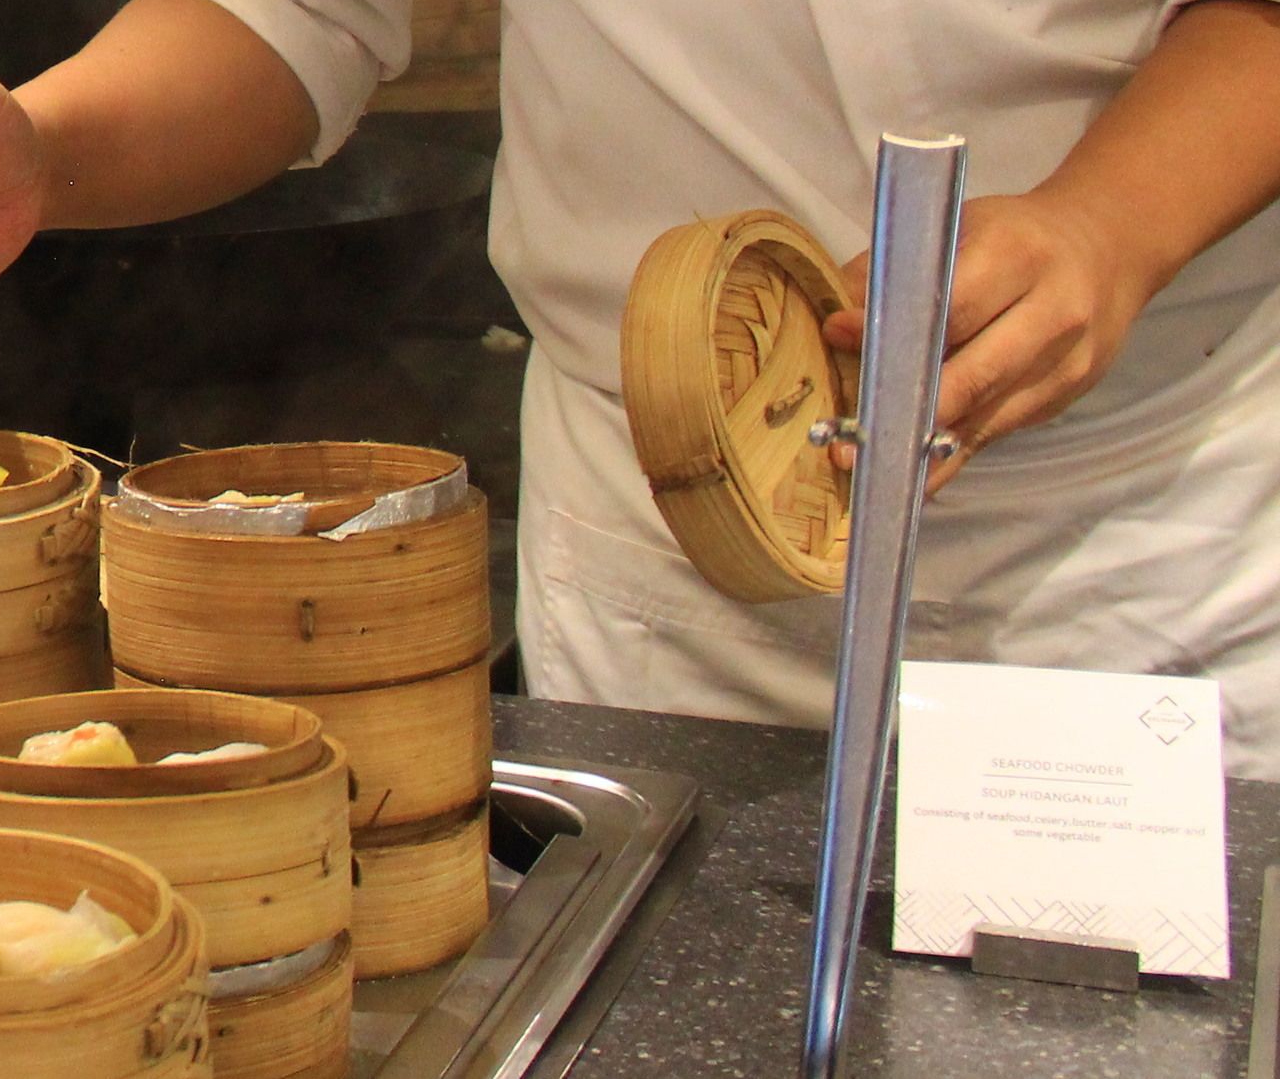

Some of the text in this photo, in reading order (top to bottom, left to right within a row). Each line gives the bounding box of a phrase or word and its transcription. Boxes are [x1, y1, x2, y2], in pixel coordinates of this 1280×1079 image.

[991, 757, 1125, 777] SEAFOOD CHOWDER
[981, 786, 1129, 808] SOUP HIDANGAN LAUT
[1013, 827, 1102, 844] some vegetable
